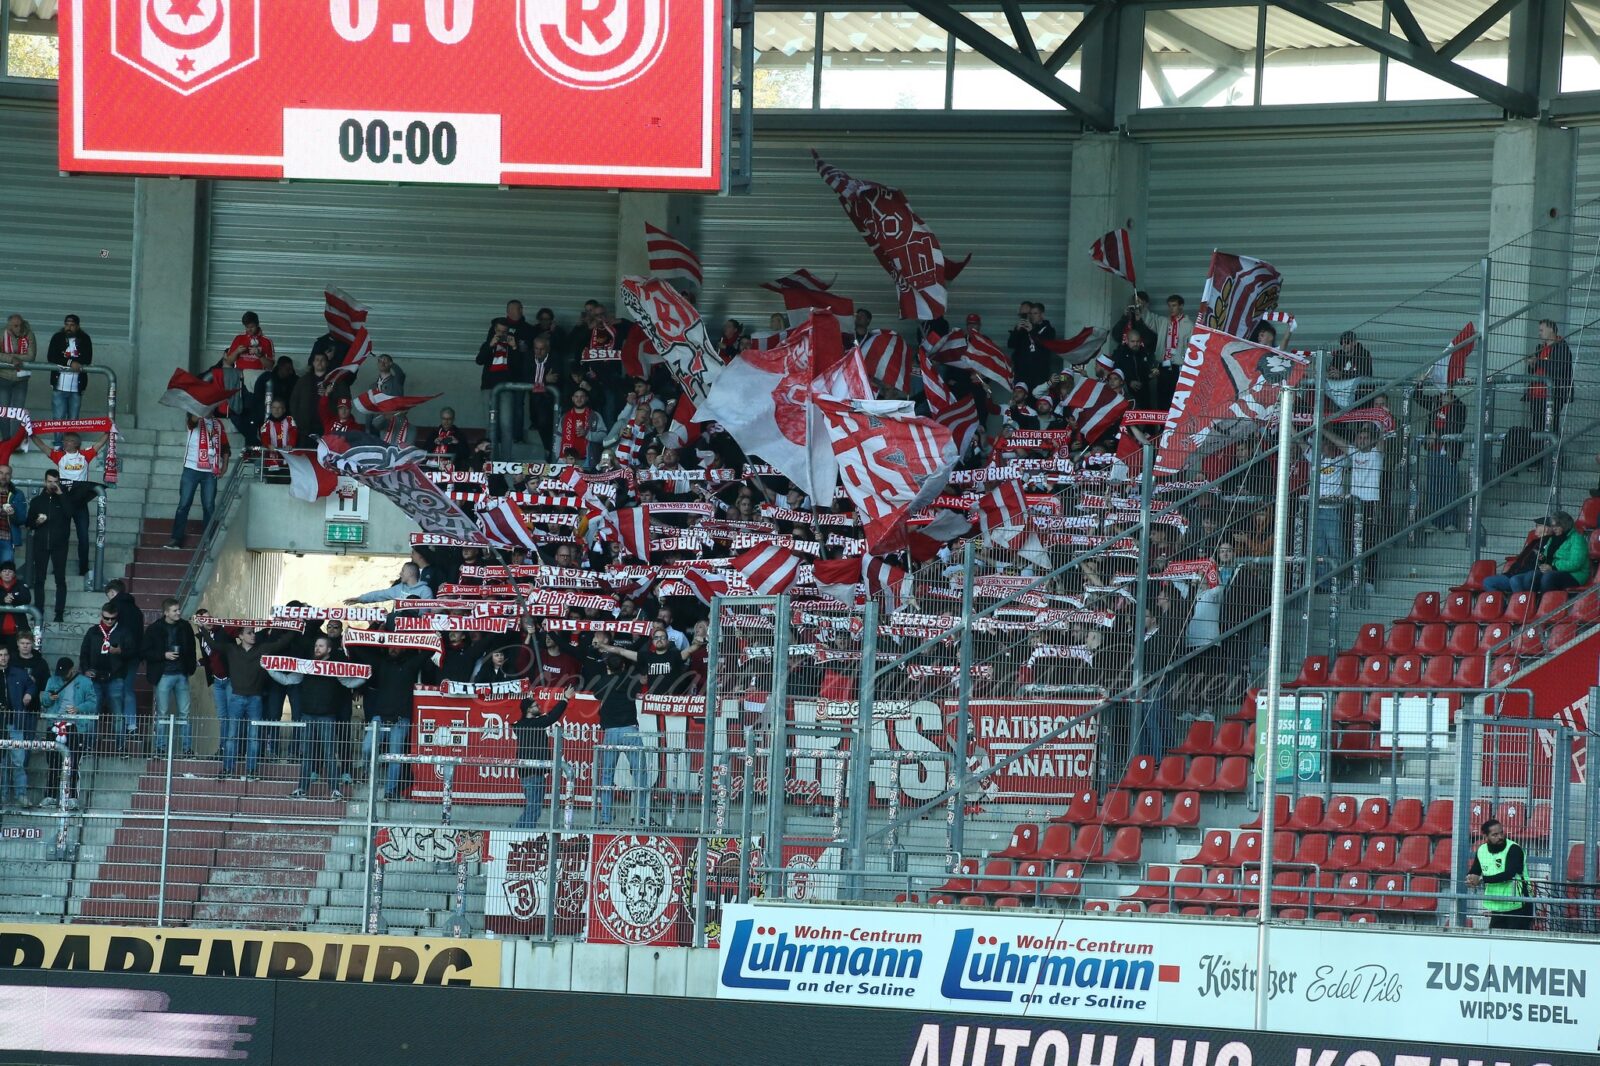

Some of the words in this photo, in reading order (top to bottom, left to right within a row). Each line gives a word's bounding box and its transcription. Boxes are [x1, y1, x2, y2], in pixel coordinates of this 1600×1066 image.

[339, 118, 457, 166] 00:00
[1007, 439, 1042, 447] JAHNELF
[270, 619, 303, 629] JAHNELF
[345, 631, 376, 643] ULTRAS
[387, 634, 441, 647] REGENSBURG
[644, 693, 690, 704] CHRISTOPH
[690, 694, 705, 704] FÜR
[644, 702, 673, 713] IMMER
[673, 703, 686, 713] BEI
[687, 704, 704, 714] UNS
[794, 924, 922, 944] Wohn-Centrum
[721, 917, 925, 991] Lührmann
[1016, 934, 1154, 955] Wohn-Centrum
[940, 927, 1155, 1003] Lührmann
[796, 981, 819, 993] an
[823, 979, 854, 994] der
[857, 981, 916, 998] Saline
[1197, 953, 1298, 999] Köstrzer
[1305, 964, 1360, 1003] Edel
[1355, 964, 1404, 1004] Pils
[1425, 960, 1588, 999] ZUSAMMEN
[1020, 991, 1043, 1004] an
[1047, 990, 1079, 1006] der
[1084, 993, 1147, 1010] Saline
[1459, 1000, 1523, 1022] WIRD'S
[1527, 1003, 1579, 1026] EDEL.
